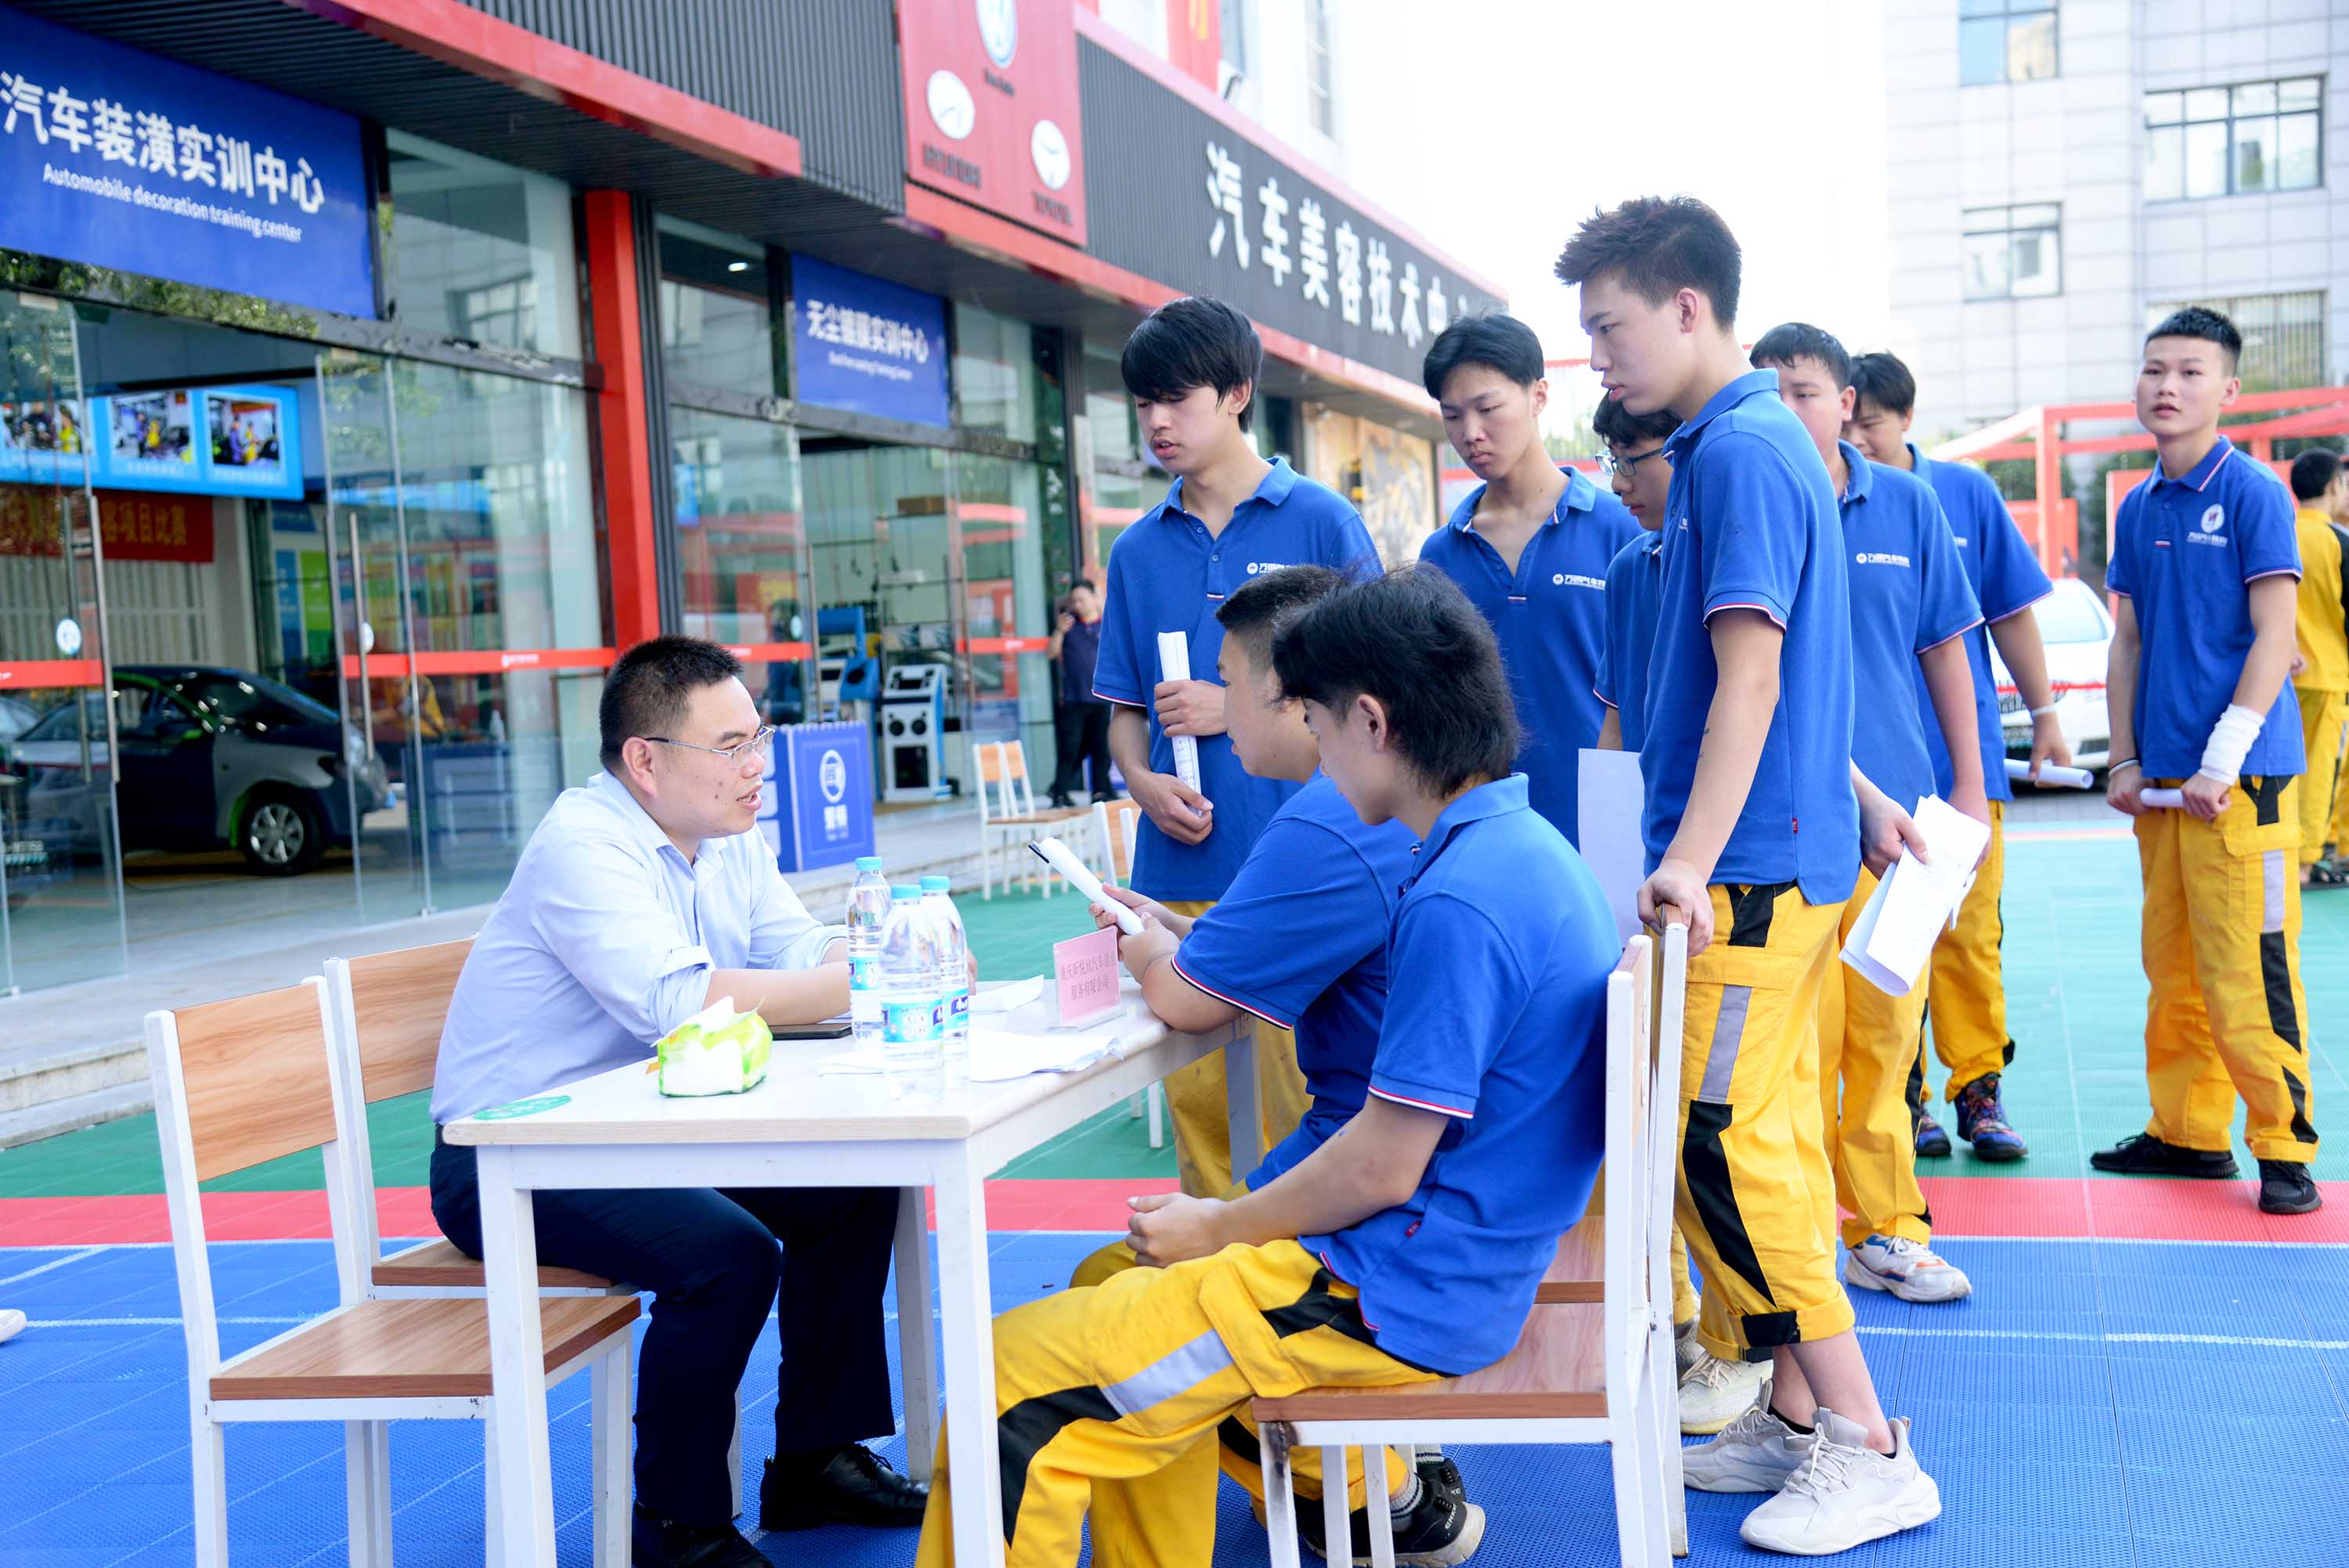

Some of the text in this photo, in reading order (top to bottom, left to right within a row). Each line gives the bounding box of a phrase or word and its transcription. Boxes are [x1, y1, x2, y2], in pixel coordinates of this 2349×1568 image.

[1, 70, 325, 214] 汽车装潢实训中心
[42, 162, 302, 243] Automobile decoration training center
[1207, 141, 1469, 350] 汽车美容技术中
